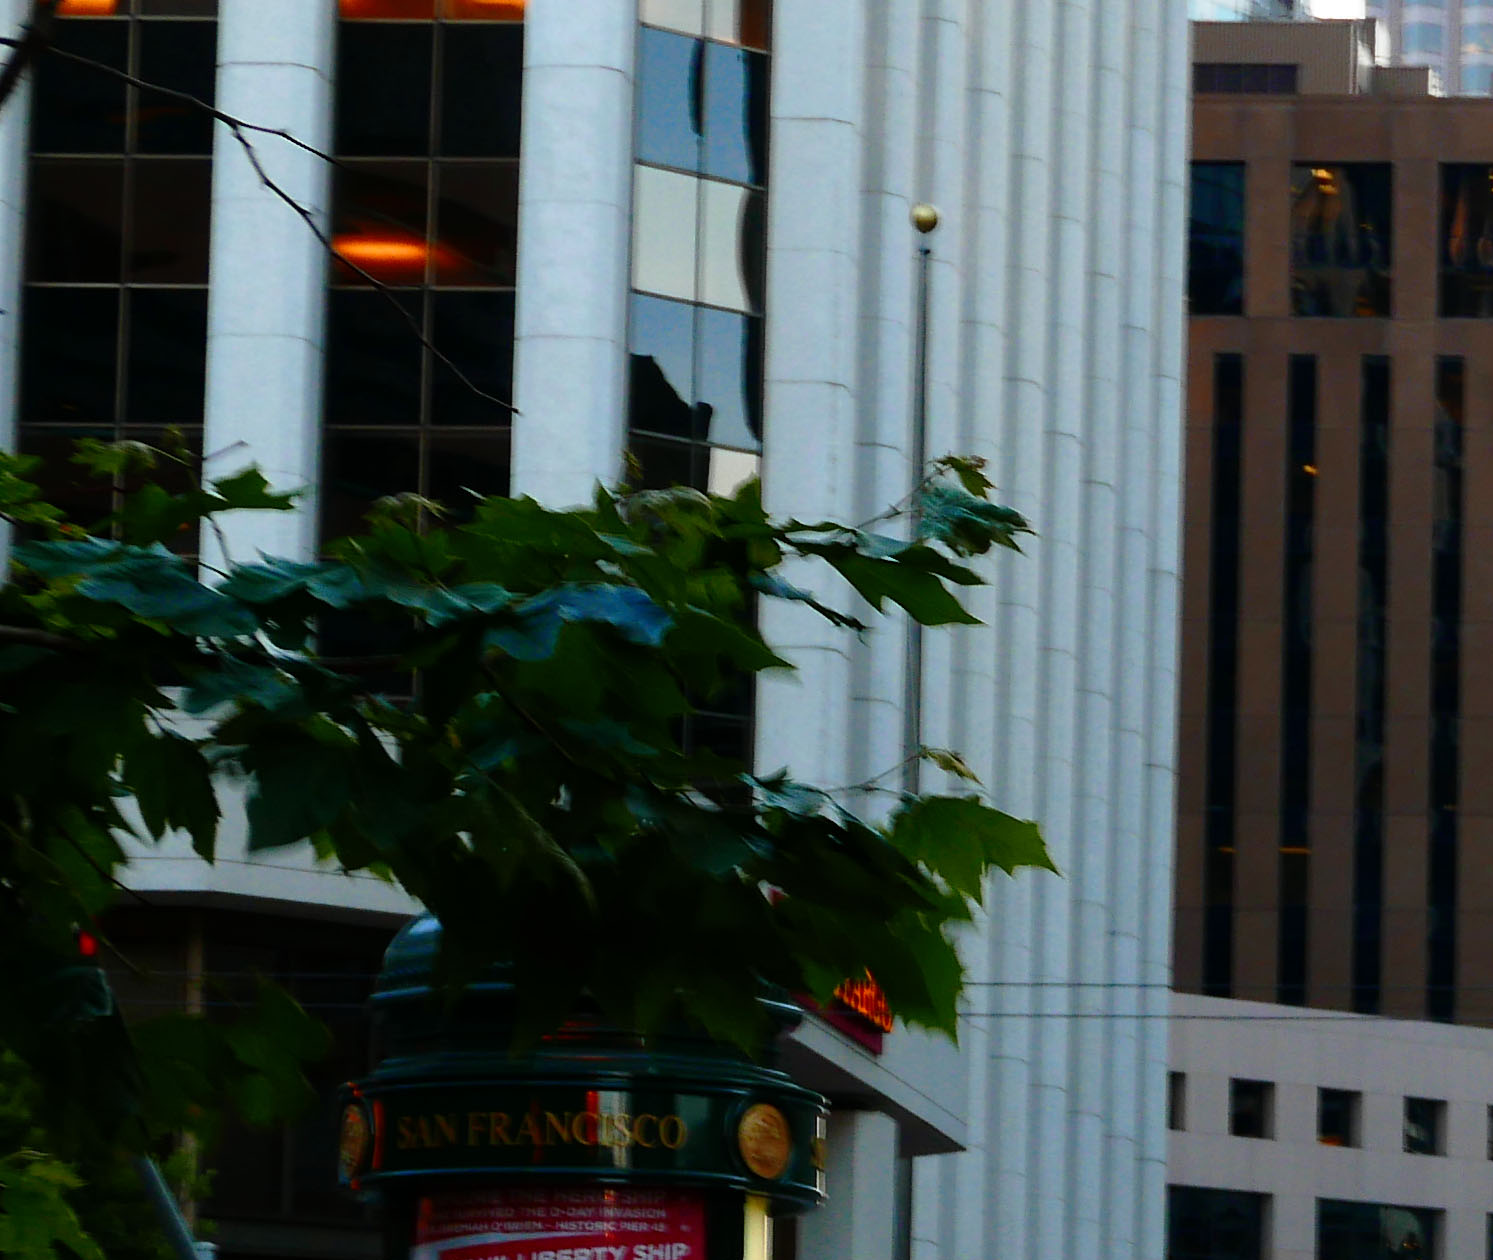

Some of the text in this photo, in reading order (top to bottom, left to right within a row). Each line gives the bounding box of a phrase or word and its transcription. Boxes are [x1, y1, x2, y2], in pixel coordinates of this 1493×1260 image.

[397, 1111, 688, 1150] SAN FRANCISCO
[556, 1220, 616, 1235] HISTORIC
[619, 1221, 649, 1234] PIER
